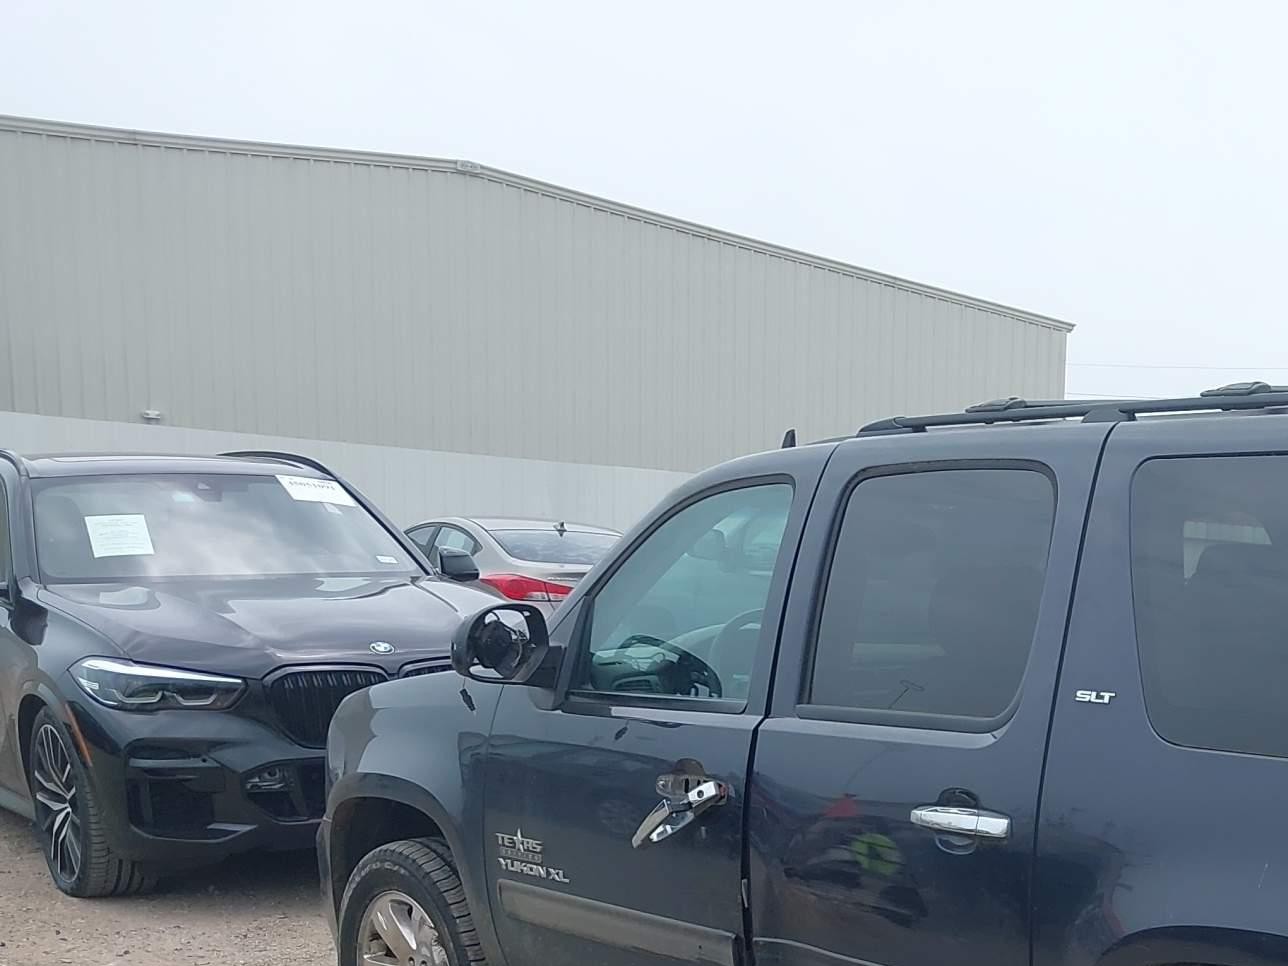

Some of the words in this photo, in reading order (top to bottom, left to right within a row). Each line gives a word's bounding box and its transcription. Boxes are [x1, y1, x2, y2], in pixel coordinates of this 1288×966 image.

[1075, 690, 1116, 704] SLT
[496, 828, 543, 852] TEXAS
[498, 858, 547, 878] YUKON
[547, 867, 570, 883] XL
